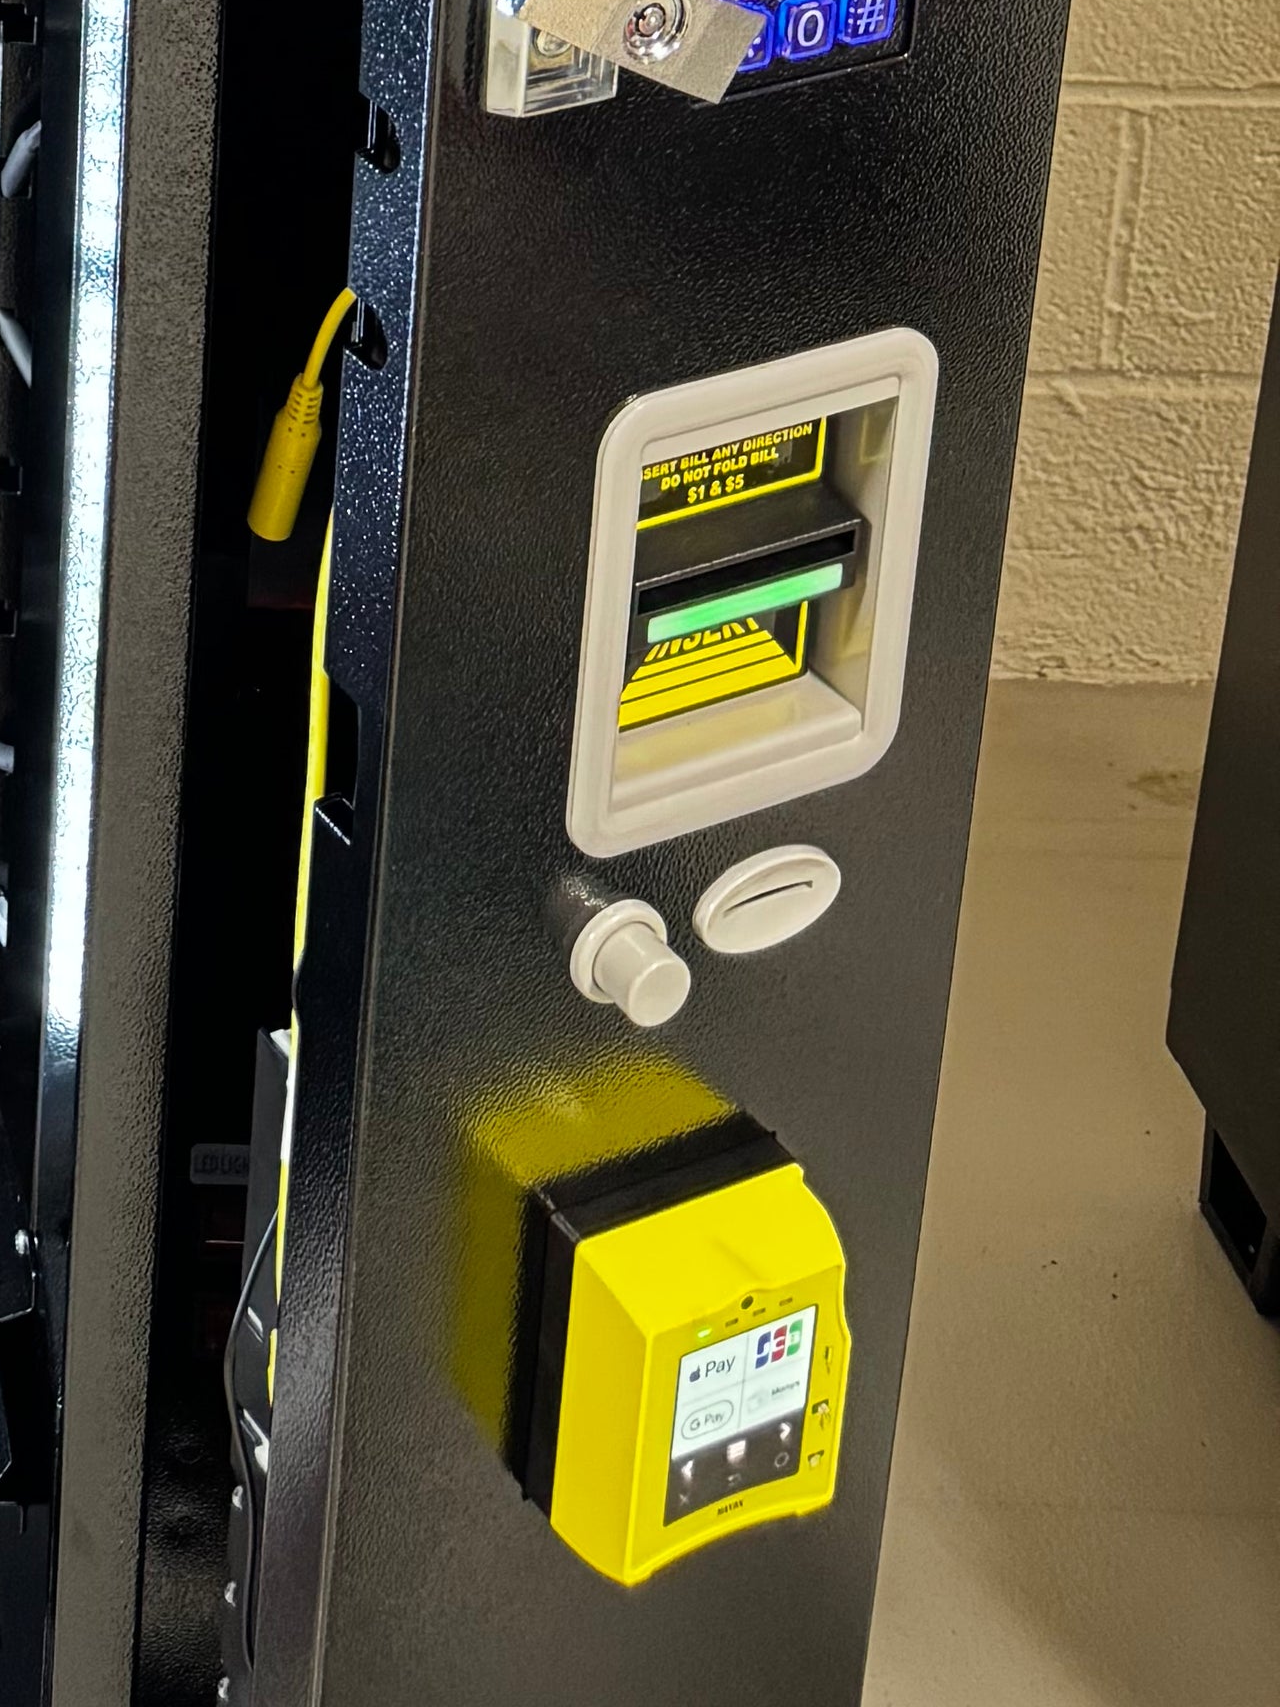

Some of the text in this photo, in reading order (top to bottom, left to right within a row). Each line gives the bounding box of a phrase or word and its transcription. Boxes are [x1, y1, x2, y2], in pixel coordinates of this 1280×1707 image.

[798, 10, 825, 47] 0
[641, 423, 813, 480] SERT BILL ANY DIRECTION
[661, 447, 779, 491] DO NOT FOLD BILL
[687, 474, 745, 503] $1 & $5
[705, 1356, 736, 1378] Pay
